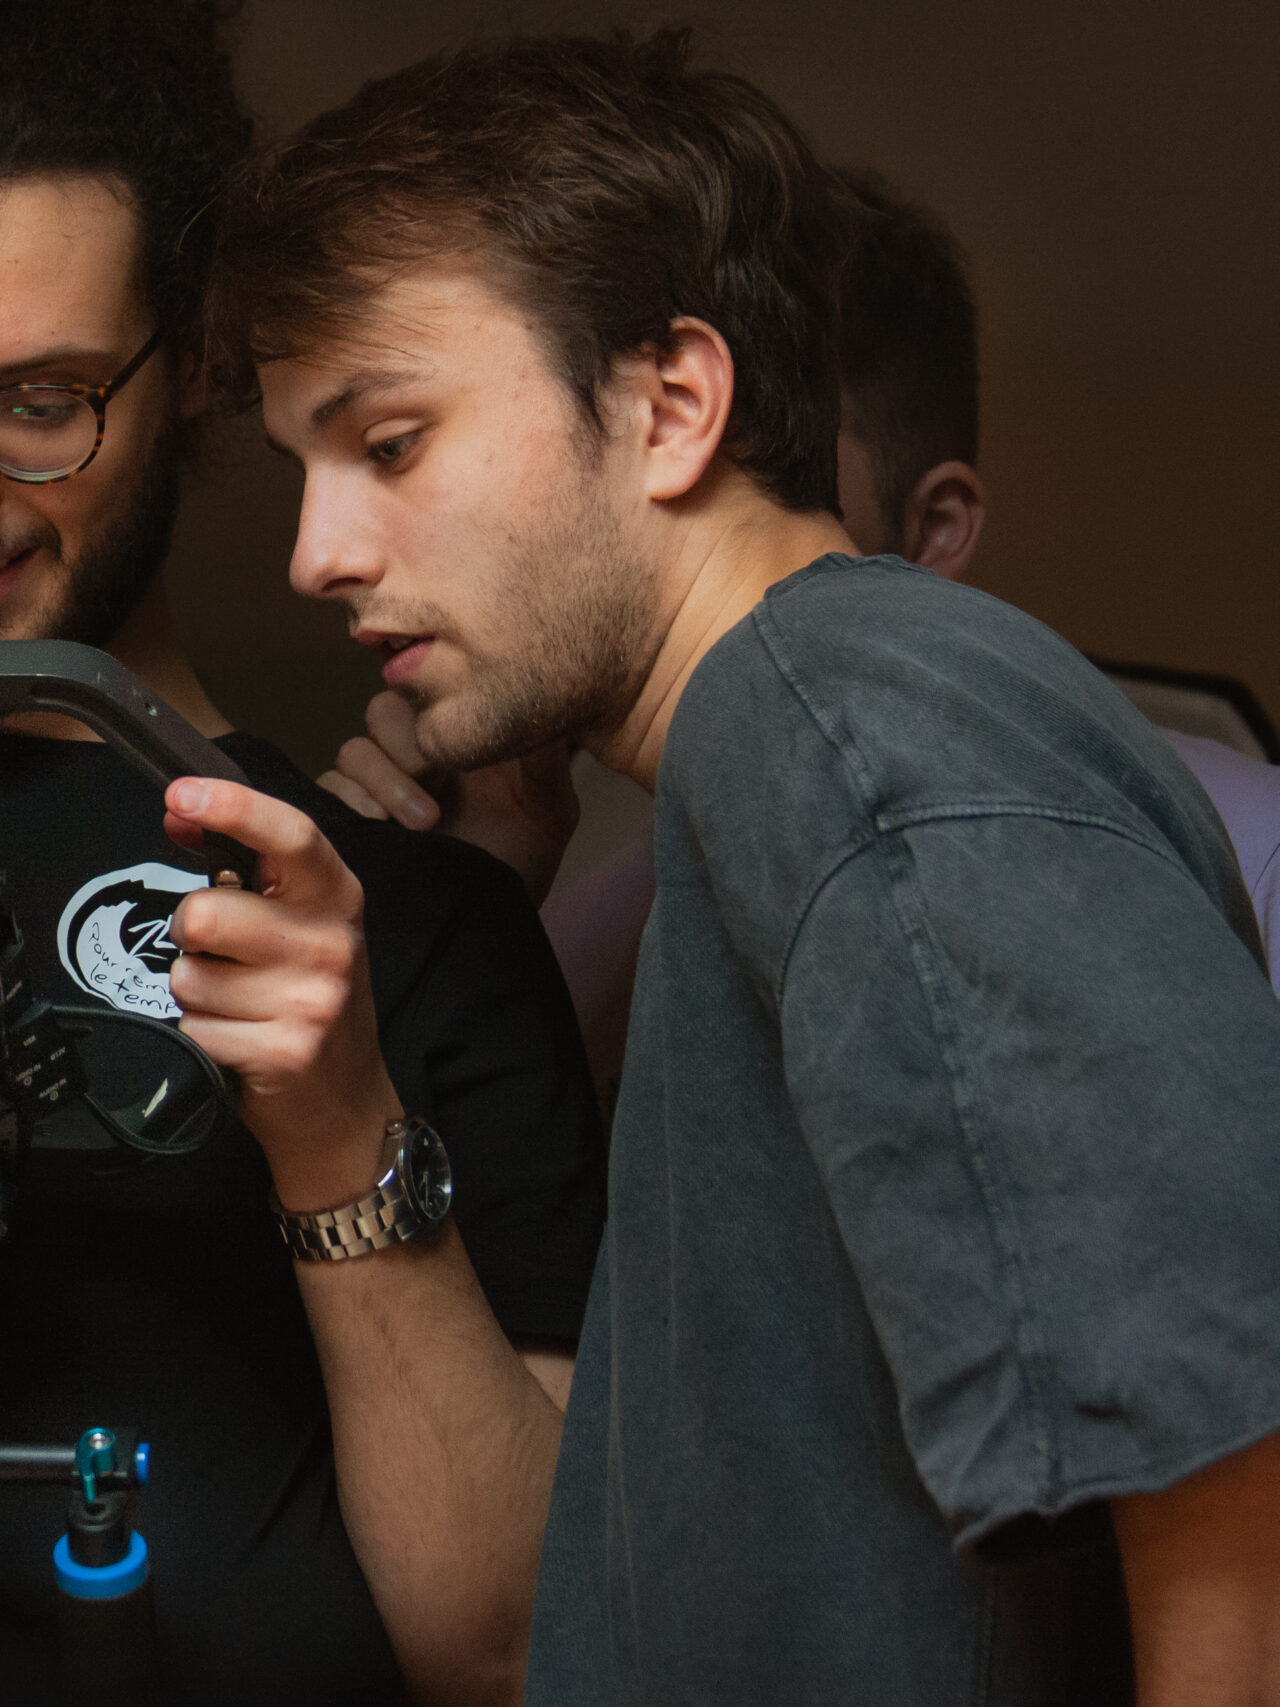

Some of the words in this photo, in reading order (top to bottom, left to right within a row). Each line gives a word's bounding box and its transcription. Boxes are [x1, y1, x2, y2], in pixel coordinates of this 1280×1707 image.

[90, 962, 108, 985] le
[113, 979, 177, 1014] temp
[125, 967, 168, 995] rem
